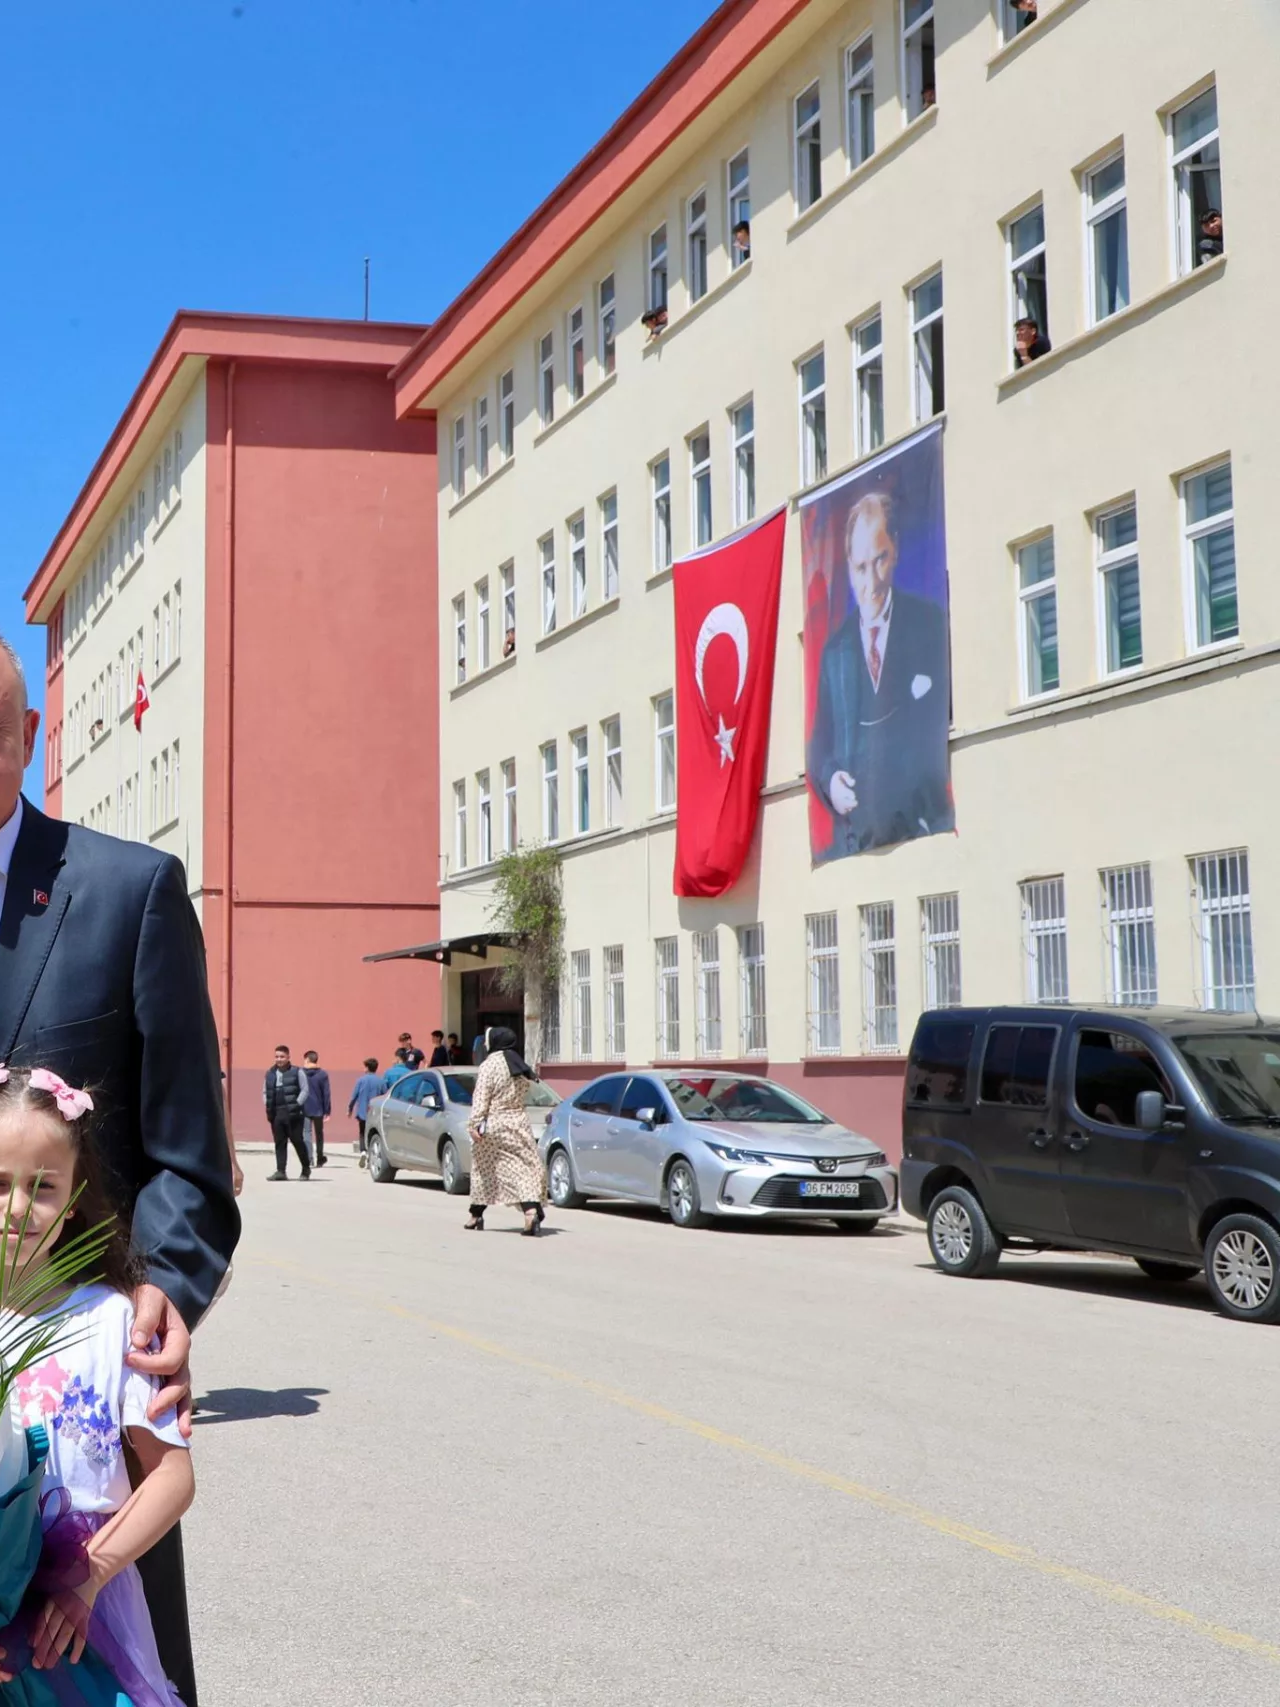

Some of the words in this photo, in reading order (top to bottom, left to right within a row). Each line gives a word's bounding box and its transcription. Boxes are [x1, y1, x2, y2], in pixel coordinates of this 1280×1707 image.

[806, 1183, 818, 1193] 06
[820, 1183, 833, 1194] FM
[834, 1183, 858, 1194] 2052
